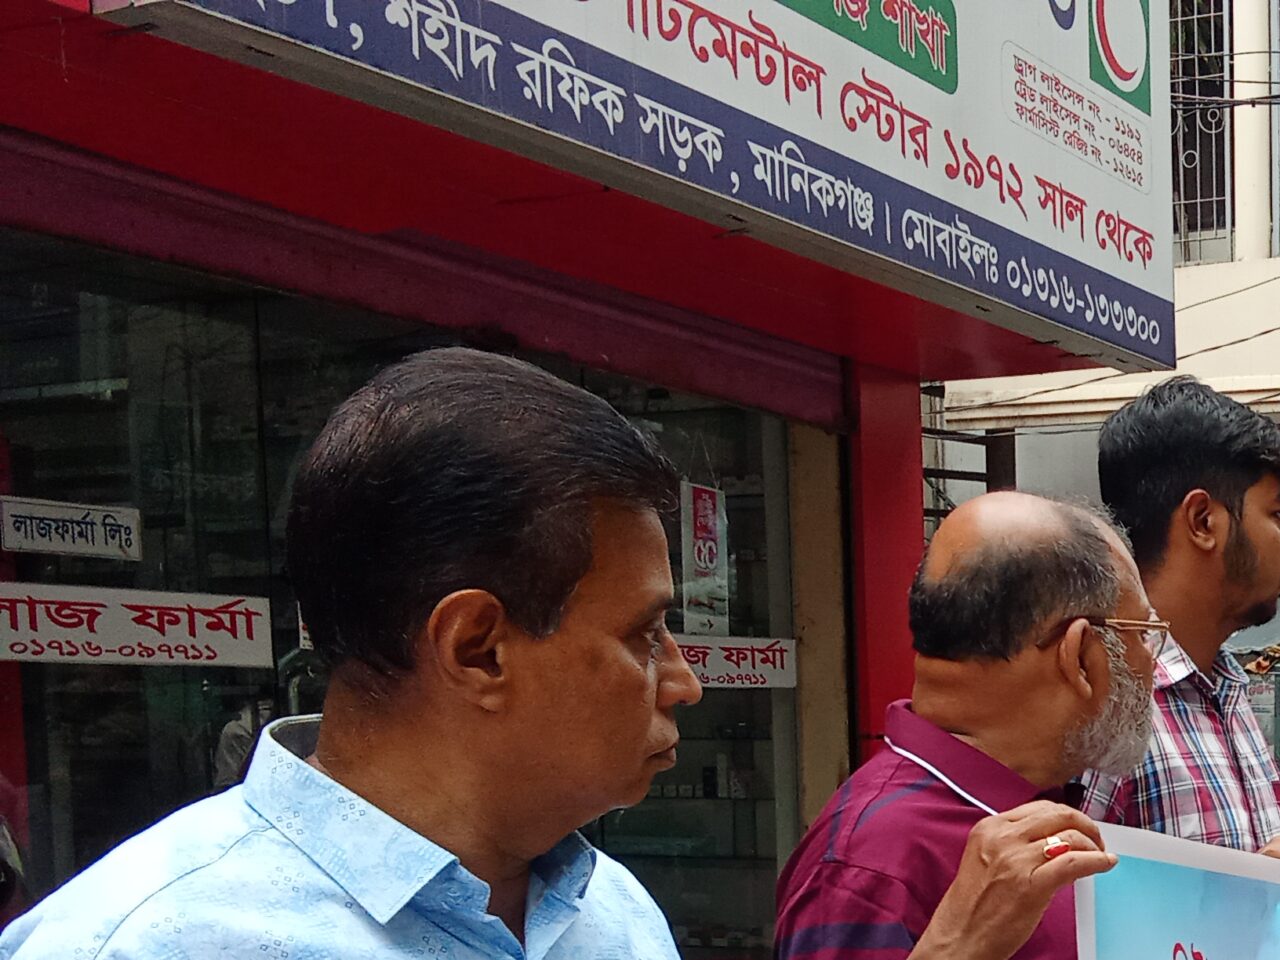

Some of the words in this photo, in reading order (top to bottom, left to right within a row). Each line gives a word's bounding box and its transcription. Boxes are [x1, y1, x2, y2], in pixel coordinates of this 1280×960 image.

[385, 0, 502, 91] শহীদ
[511, 38, 625, 135] রফিক
[634, 93, 724, 176] সড়ক
[902, 208, 999, 284] মোবাইলঃ
[1006, 257, 1160, 345] ০১৩১৬-১৩৩৩০০
[841, 68, 931, 168] স্টোর
[945, 130, 1028, 221] ১৯৭২
[1035, 174, 1088, 241] সাল
[1096, 208, 1155, 270] থেকে
[10, 512, 97, 546] লাজফার্মা
[121, 599, 263, 640] ফার্মা
[10, 638, 218, 660] ০১৭১৬-০৯৭৭১১
[719, 640, 788, 671] ফার্মা
